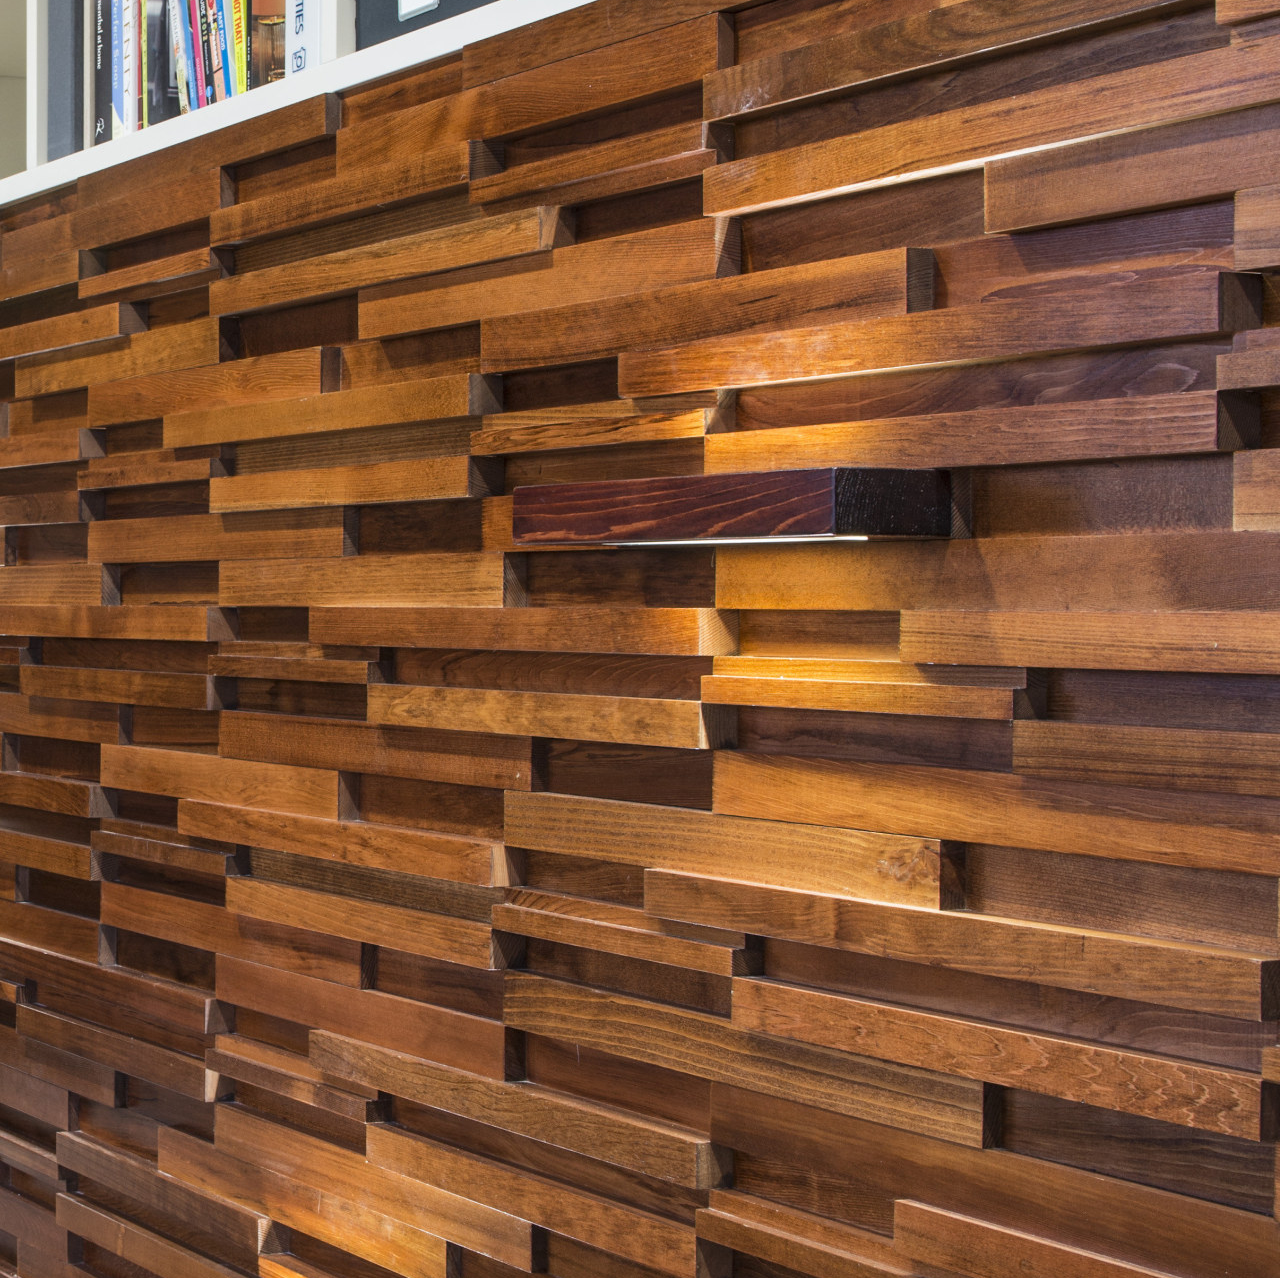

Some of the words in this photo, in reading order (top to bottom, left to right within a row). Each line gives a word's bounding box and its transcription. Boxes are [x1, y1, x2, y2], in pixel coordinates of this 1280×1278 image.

[96, 34, 103, 44] at
[234, 15, 242, 46] THAT!
[112, 49, 120, 89] Scoop
